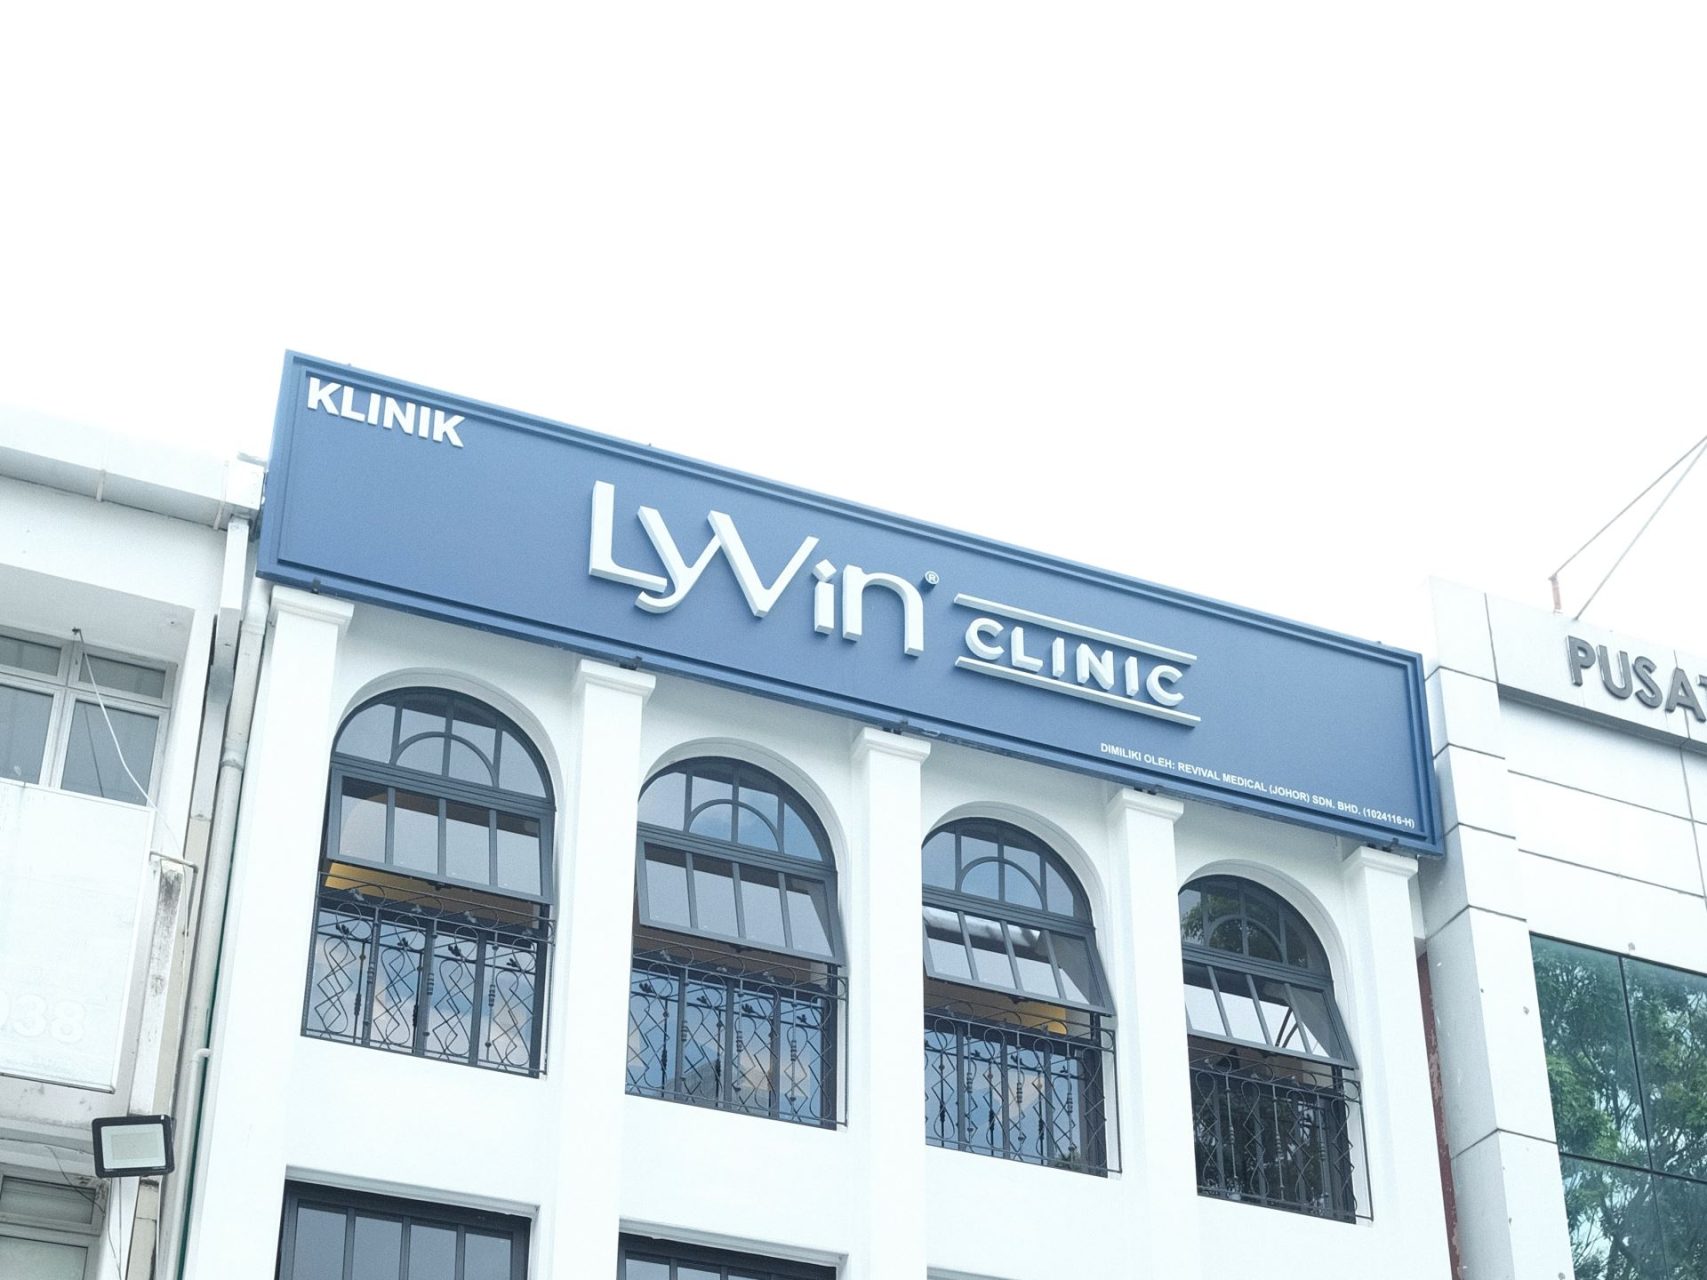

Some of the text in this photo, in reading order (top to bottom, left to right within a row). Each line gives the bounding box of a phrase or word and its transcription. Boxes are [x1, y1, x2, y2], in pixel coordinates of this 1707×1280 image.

[307, 376, 465, 448] KLINIK
[964, 616, 1185, 707] CLINIC
[1565, 634, 1707, 724] PUSA
[1100, 742, 1142, 762] DIMILIKI
[1143, 752, 1176, 771] OLEH:
[1177, 761, 1221, 782] REVIVAL
[1222, 772, 1268, 793] MEDICAL
[1269, 783, 1311, 804] (JOHOR)
[1312, 794, 1336, 809] SDN.
[1337, 801, 1362, 816] BHD.
